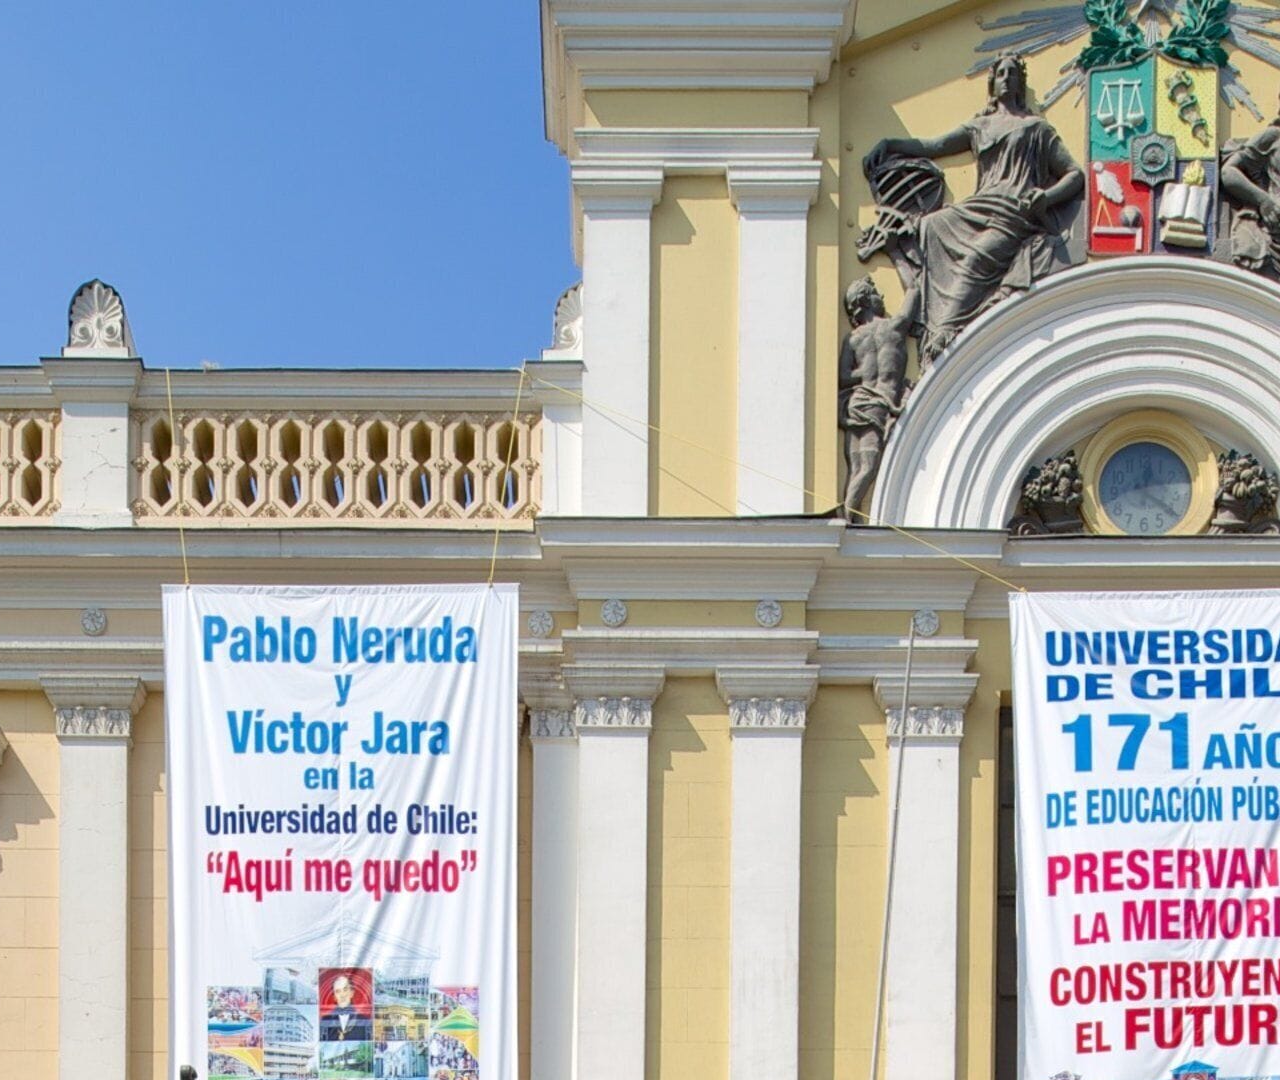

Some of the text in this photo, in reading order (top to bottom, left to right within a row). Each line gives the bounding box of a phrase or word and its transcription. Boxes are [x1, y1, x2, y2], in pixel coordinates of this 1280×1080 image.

[1125, 513, 1133, 528] 7
[1140, 517, 1148, 532] 6
[1155, 513, 1164, 528] 5
[202, 615, 478, 665] Pablo Neruda
[335, 673, 352, 707] y
[1046, 672, 1113, 703] DE
[226, 708, 449, 757] Víctor Jara
[1061, 711, 1190, 773] 171
[303, 762, 375, 791] en la
[205, 803, 478, 834] Universidad de Chile:
[1046, 790, 1077, 829] DE
[1086, 777, 1223, 825] EDUCACIÓN
[207, 848, 478, 902] “Aquí me quedo”
[1074, 912, 1110, 946] LA
[1076, 1022, 1111, 1054] EL
